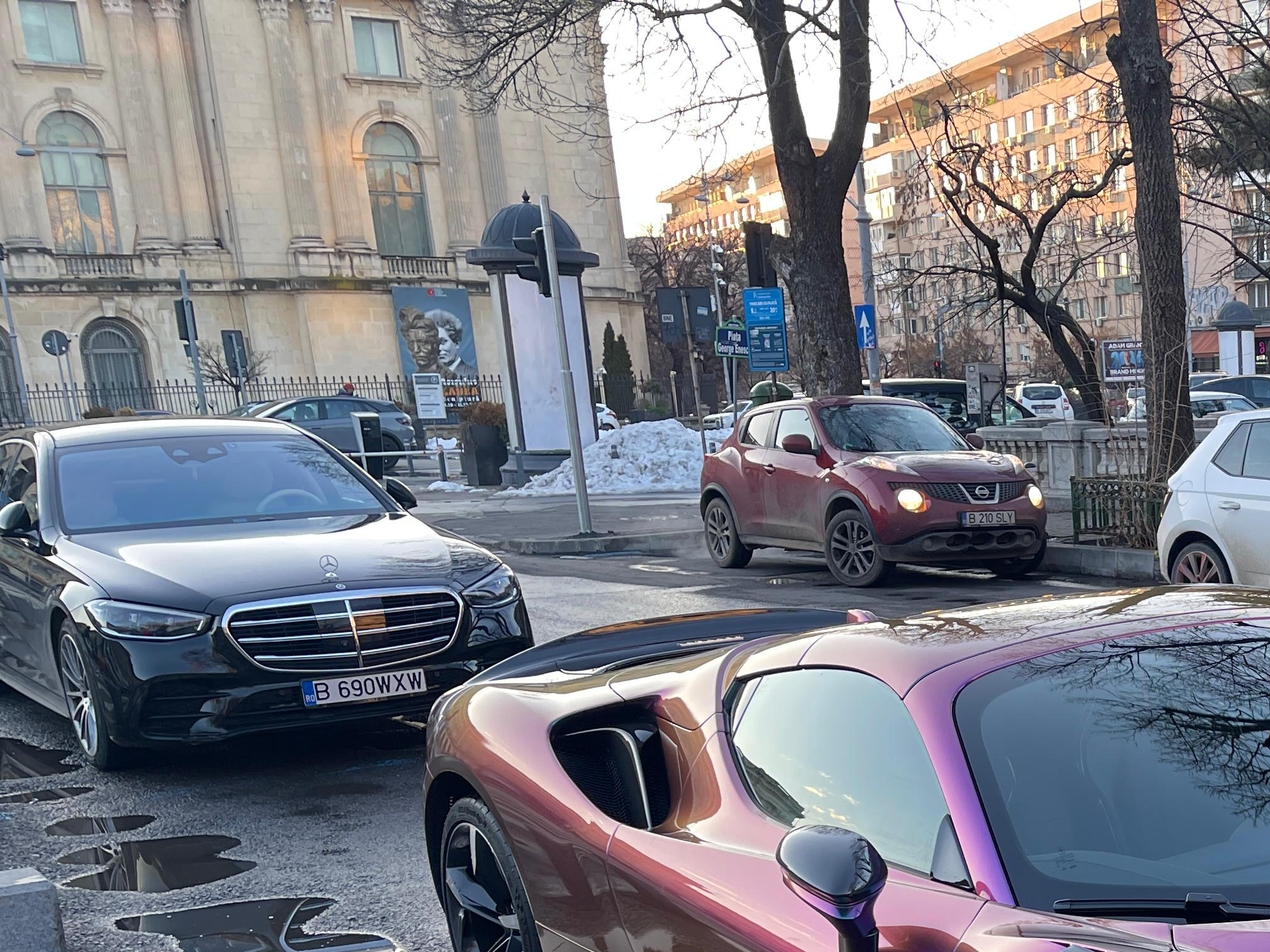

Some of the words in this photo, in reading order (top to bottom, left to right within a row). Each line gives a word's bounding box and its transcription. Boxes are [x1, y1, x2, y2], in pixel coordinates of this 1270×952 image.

[717, 342, 735, 355] George
[735, 343, 749, 355] Enesc
[969, 513, 976, 524] B
[979, 513, 994, 524] 210
[996, 512, 1013, 523] SLY
[314, 682, 331, 701] B
[305, 694, 315, 703] RO
